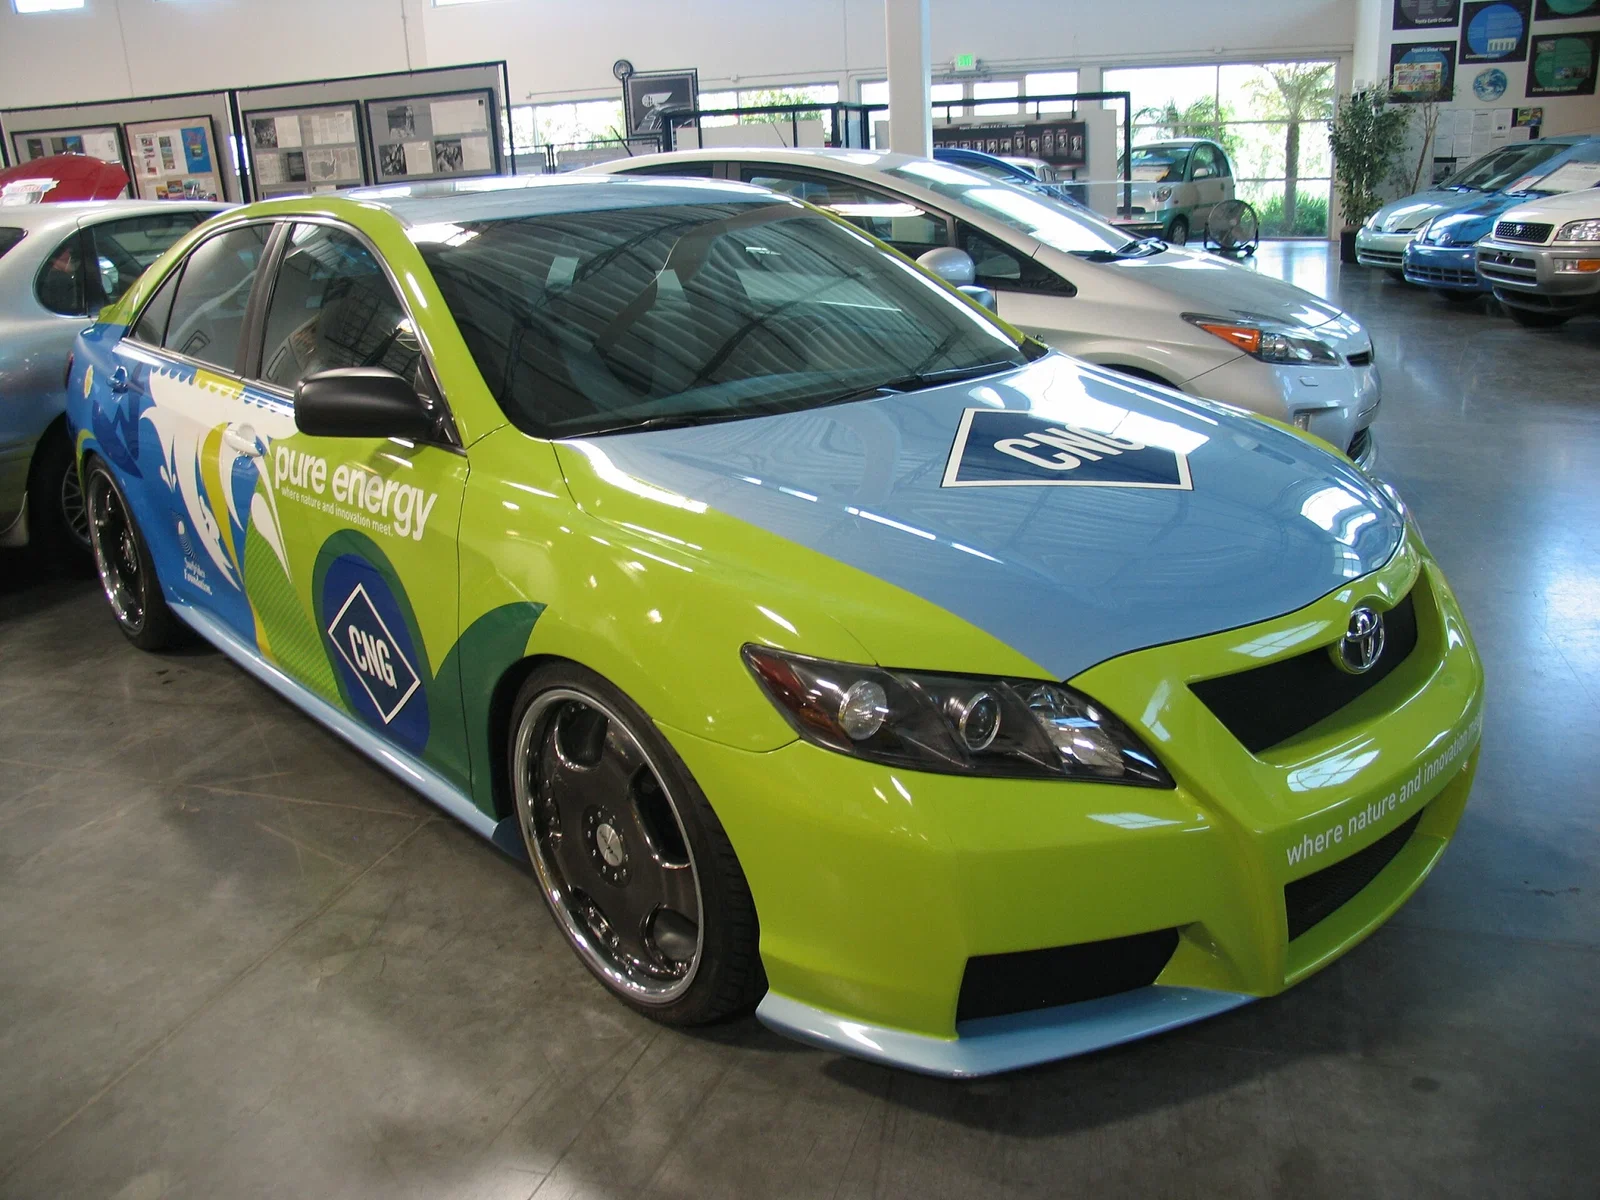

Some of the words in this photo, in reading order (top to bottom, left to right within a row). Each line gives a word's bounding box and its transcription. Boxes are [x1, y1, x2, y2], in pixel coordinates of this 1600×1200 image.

[275, 446, 327, 494] pure
[332, 464, 437, 541] energy
[282, 486, 299, 501] where
[300, 493, 321, 510] nature
[322, 501, 334, 515] and
[335, 504, 371, 528] innovation
[348, 625, 397, 689] CNG
[1286, 824, 1343, 866] where
[1348, 792, 1396, 836] nature
[1399, 768, 1422, 803] and
[1423, 729, 1468, 785] innovation
